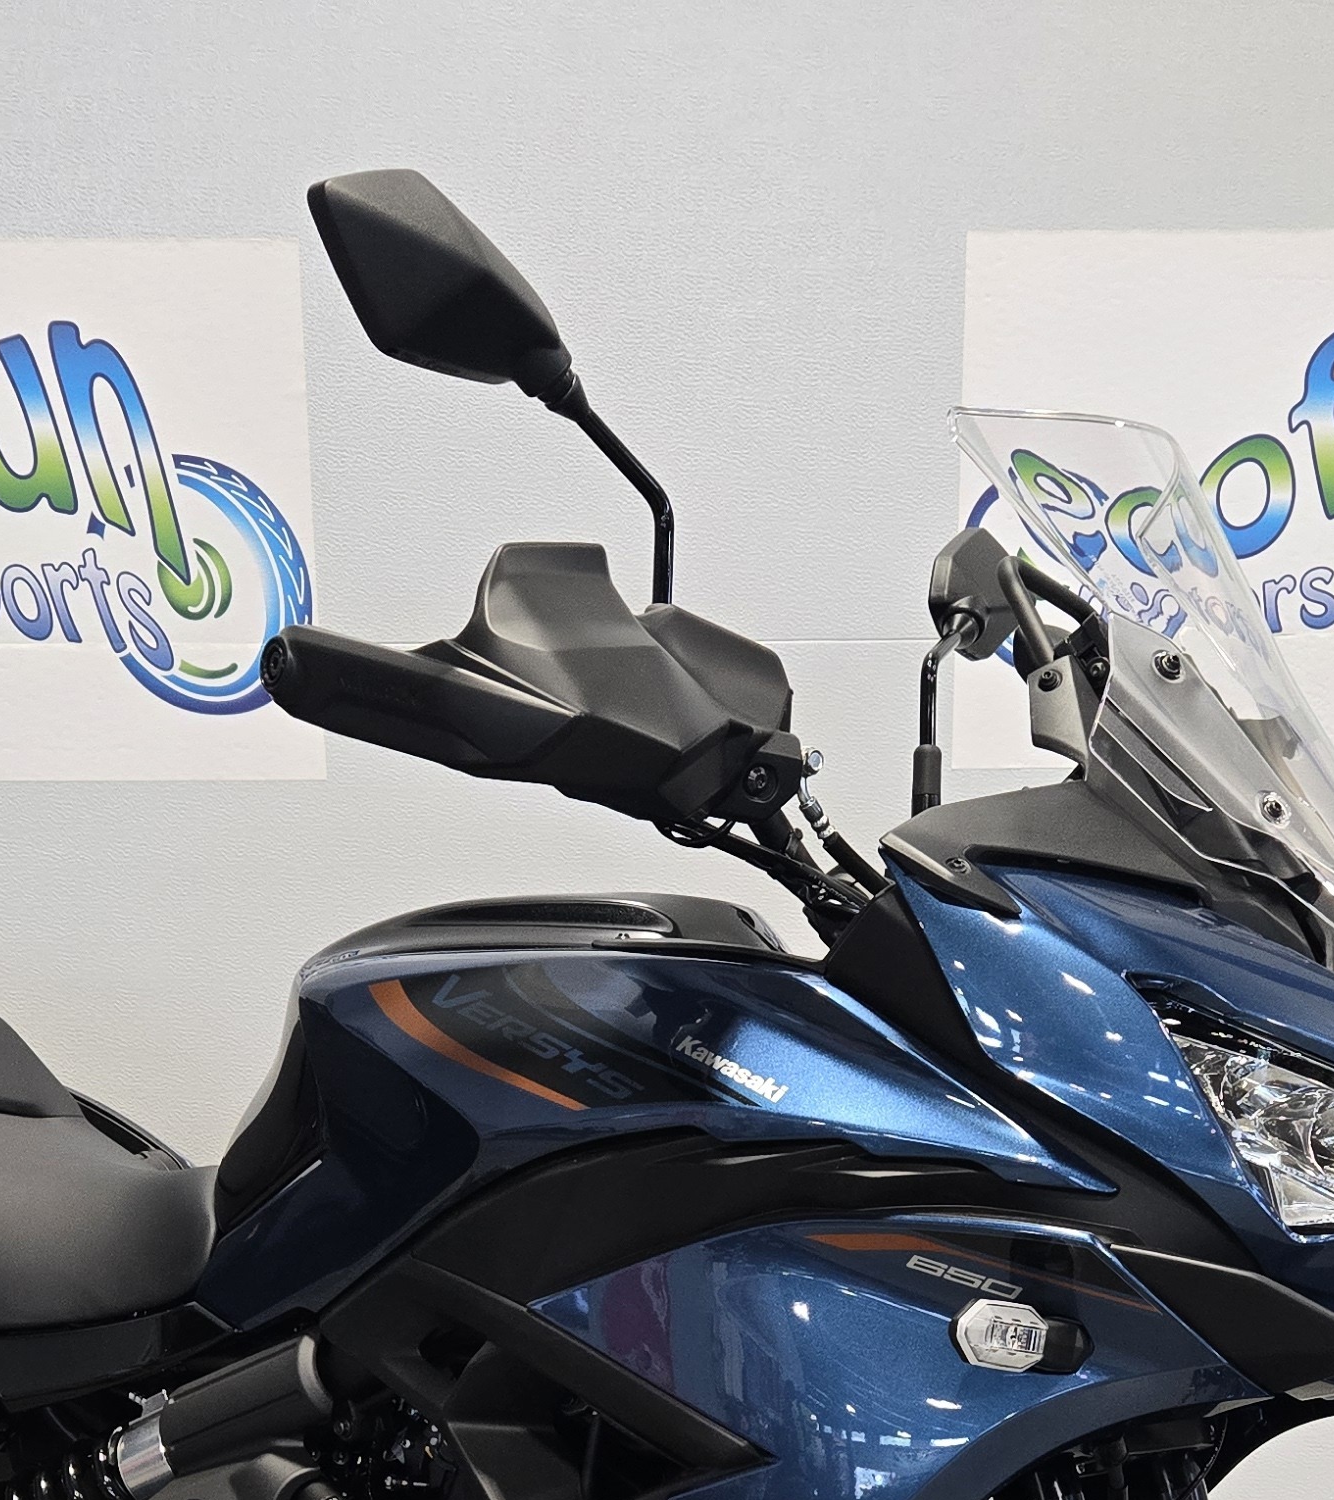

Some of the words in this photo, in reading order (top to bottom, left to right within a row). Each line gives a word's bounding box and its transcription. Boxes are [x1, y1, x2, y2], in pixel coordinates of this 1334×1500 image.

[431, 974, 646, 1100] VERSYS
[675, 1035, 789, 1103] Kawasaki
[905, 1254, 1024, 1300] 650
